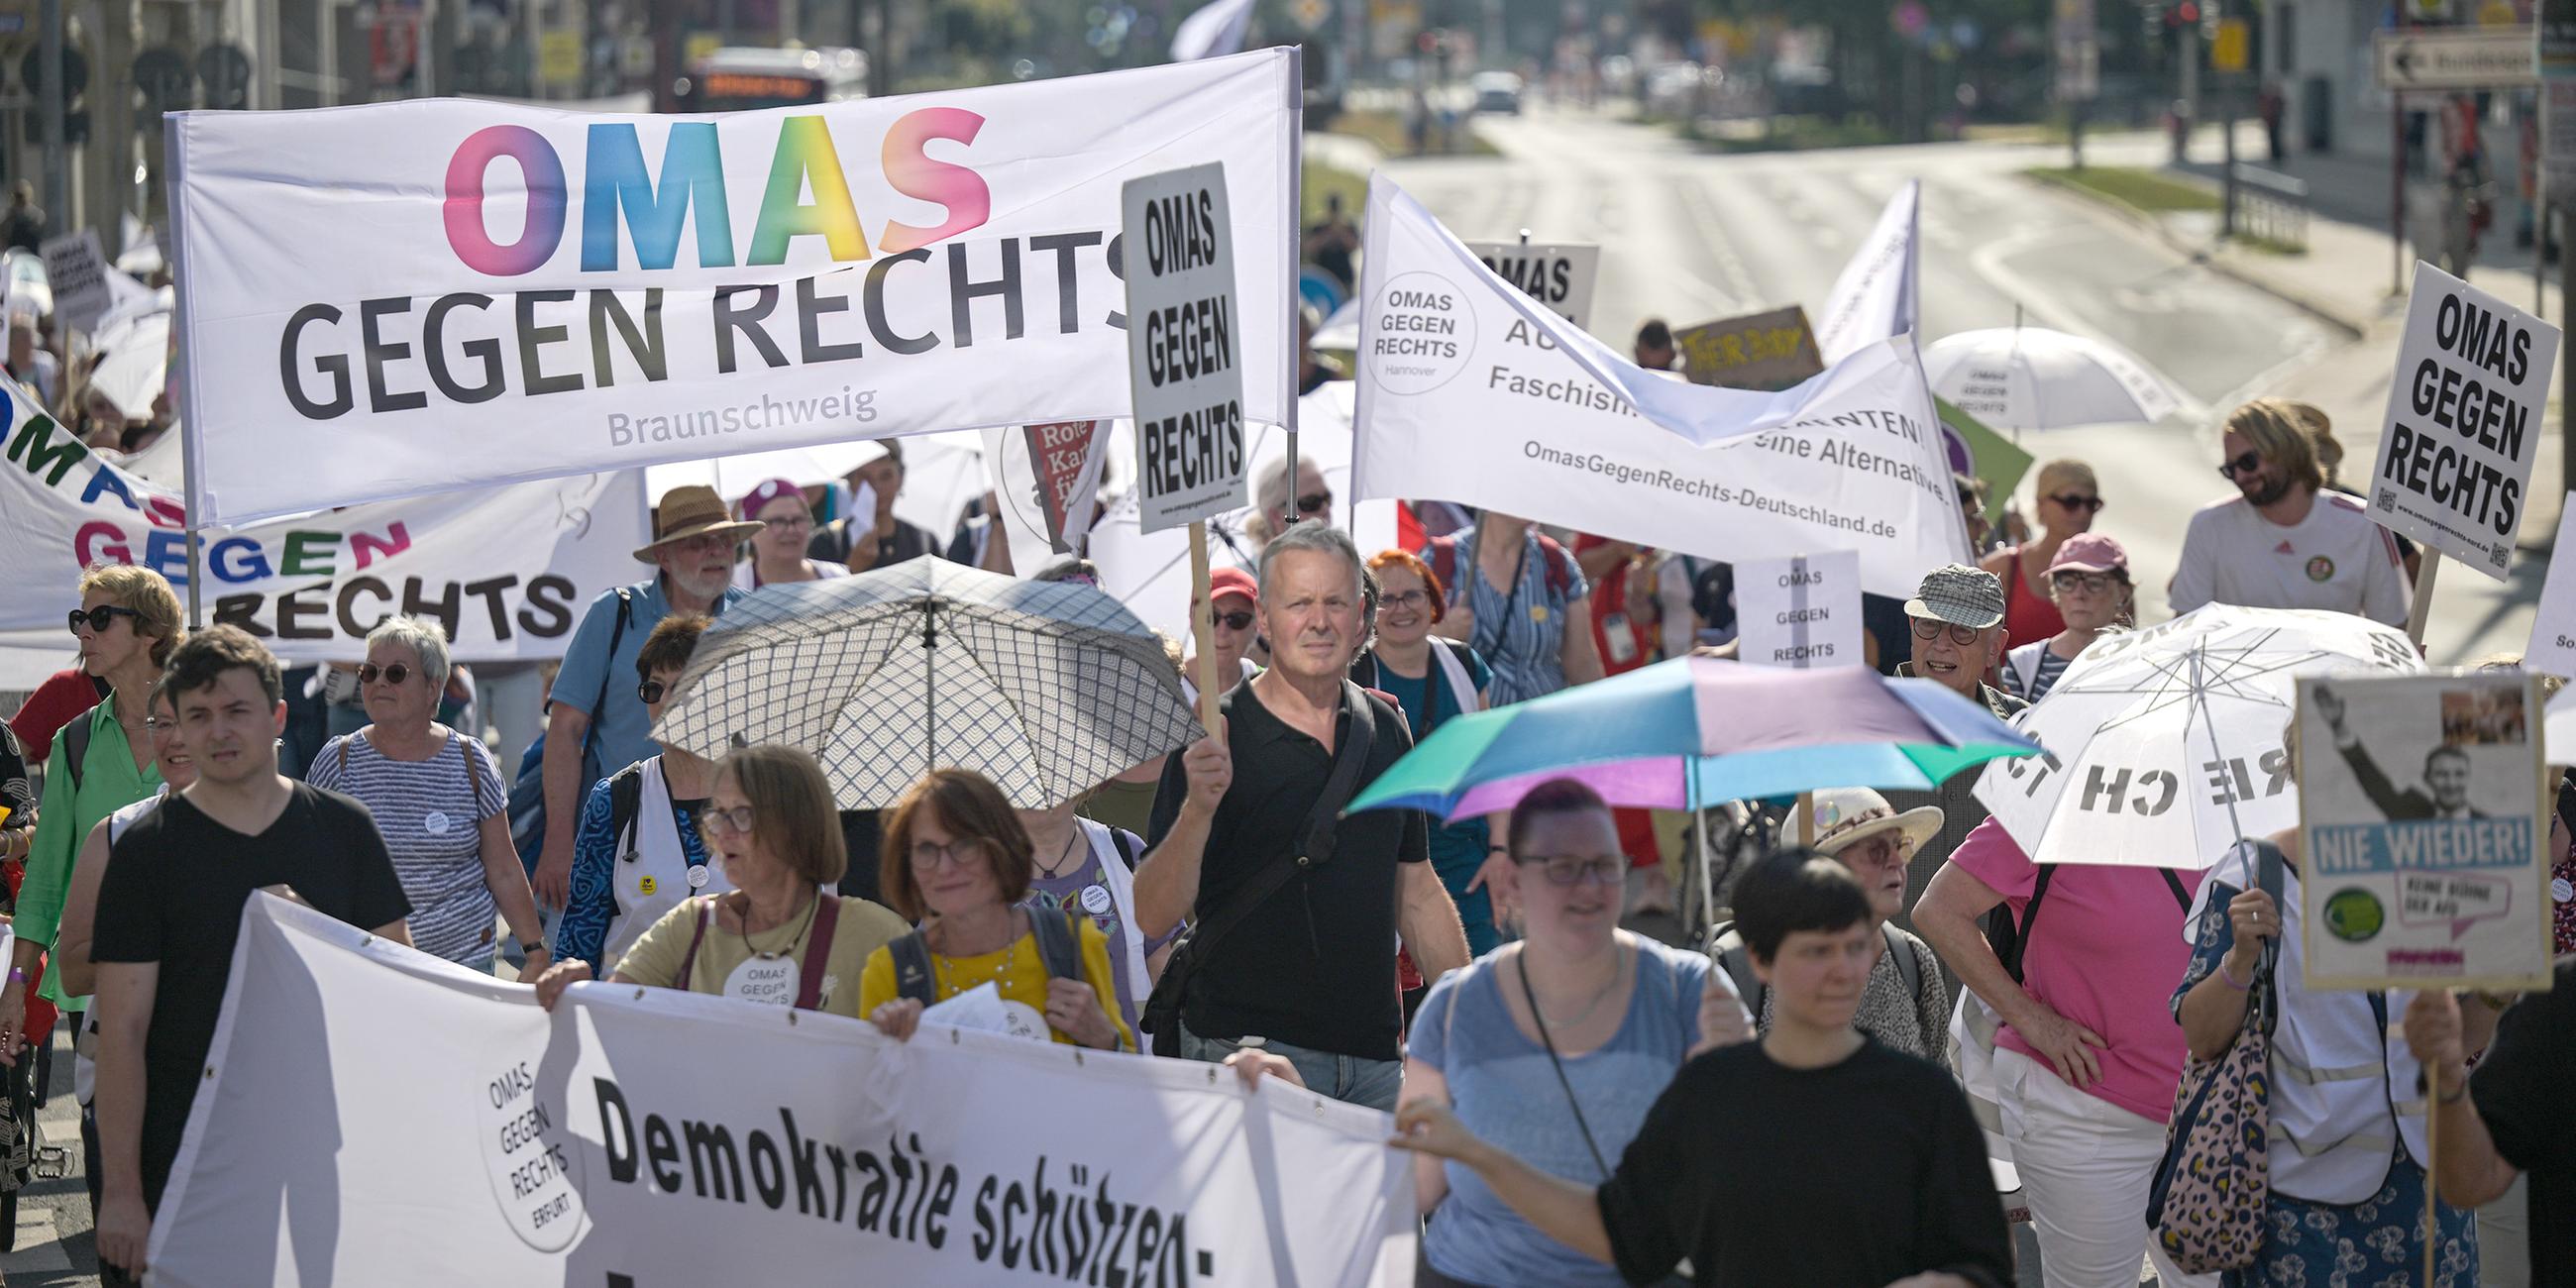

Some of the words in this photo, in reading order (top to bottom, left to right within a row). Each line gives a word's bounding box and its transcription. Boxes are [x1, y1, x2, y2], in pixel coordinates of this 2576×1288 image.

[443, 106, 991, 275] OMAS
[1145, 188, 1216, 278] OMAS
[1381, 314, 1455, 336] GEGEN
[1388, 290, 1453, 312] OMAS
[280, 285, 669, 420] GEGEN
[1146, 294, 1231, 388] GEGEN
[1374, 338, 1457, 359] RECHTS
[1385, 364, 1437, 377] Hannover
[2436, 293, 2531, 386] OMAS
[606, 384, 878, 447] Braunschweig
[2412, 358, 2528, 463] GEGEN
[1145, 400, 1242, 498] RECHTS
[1819, 439, 1950, 507] Alternative.
[2383, 422, 2520, 537] RECHTS
[1524, 440, 1896, 538] OmasGegenRechts-Deutschland.de
[74, 520, 412, 587] GEGEN
[2398, 503, 2489, 553] www.omasgegenrechts-nord.de
[212, 575, 578, 646] RECHTS
[1778, 571, 1823, 588] OMAS
[1775, 607, 1830, 625] GEGEN
[1773, 643, 1835, 663] RECHTS
[2317, 827, 2374, 870] NIE
[2382, 820, 2527, 868] WIEDER!
[489, 1061, 534, 1110] OMAS
[500, 1101, 552, 1155] GEGEN
[510, 1142, 569, 1201] RECHTS
[594, 1076, 959, 1250] Demokratie
[973, 1155, 1214, 1288] schützen-
[532, 1192, 571, 1230] ERFURT
